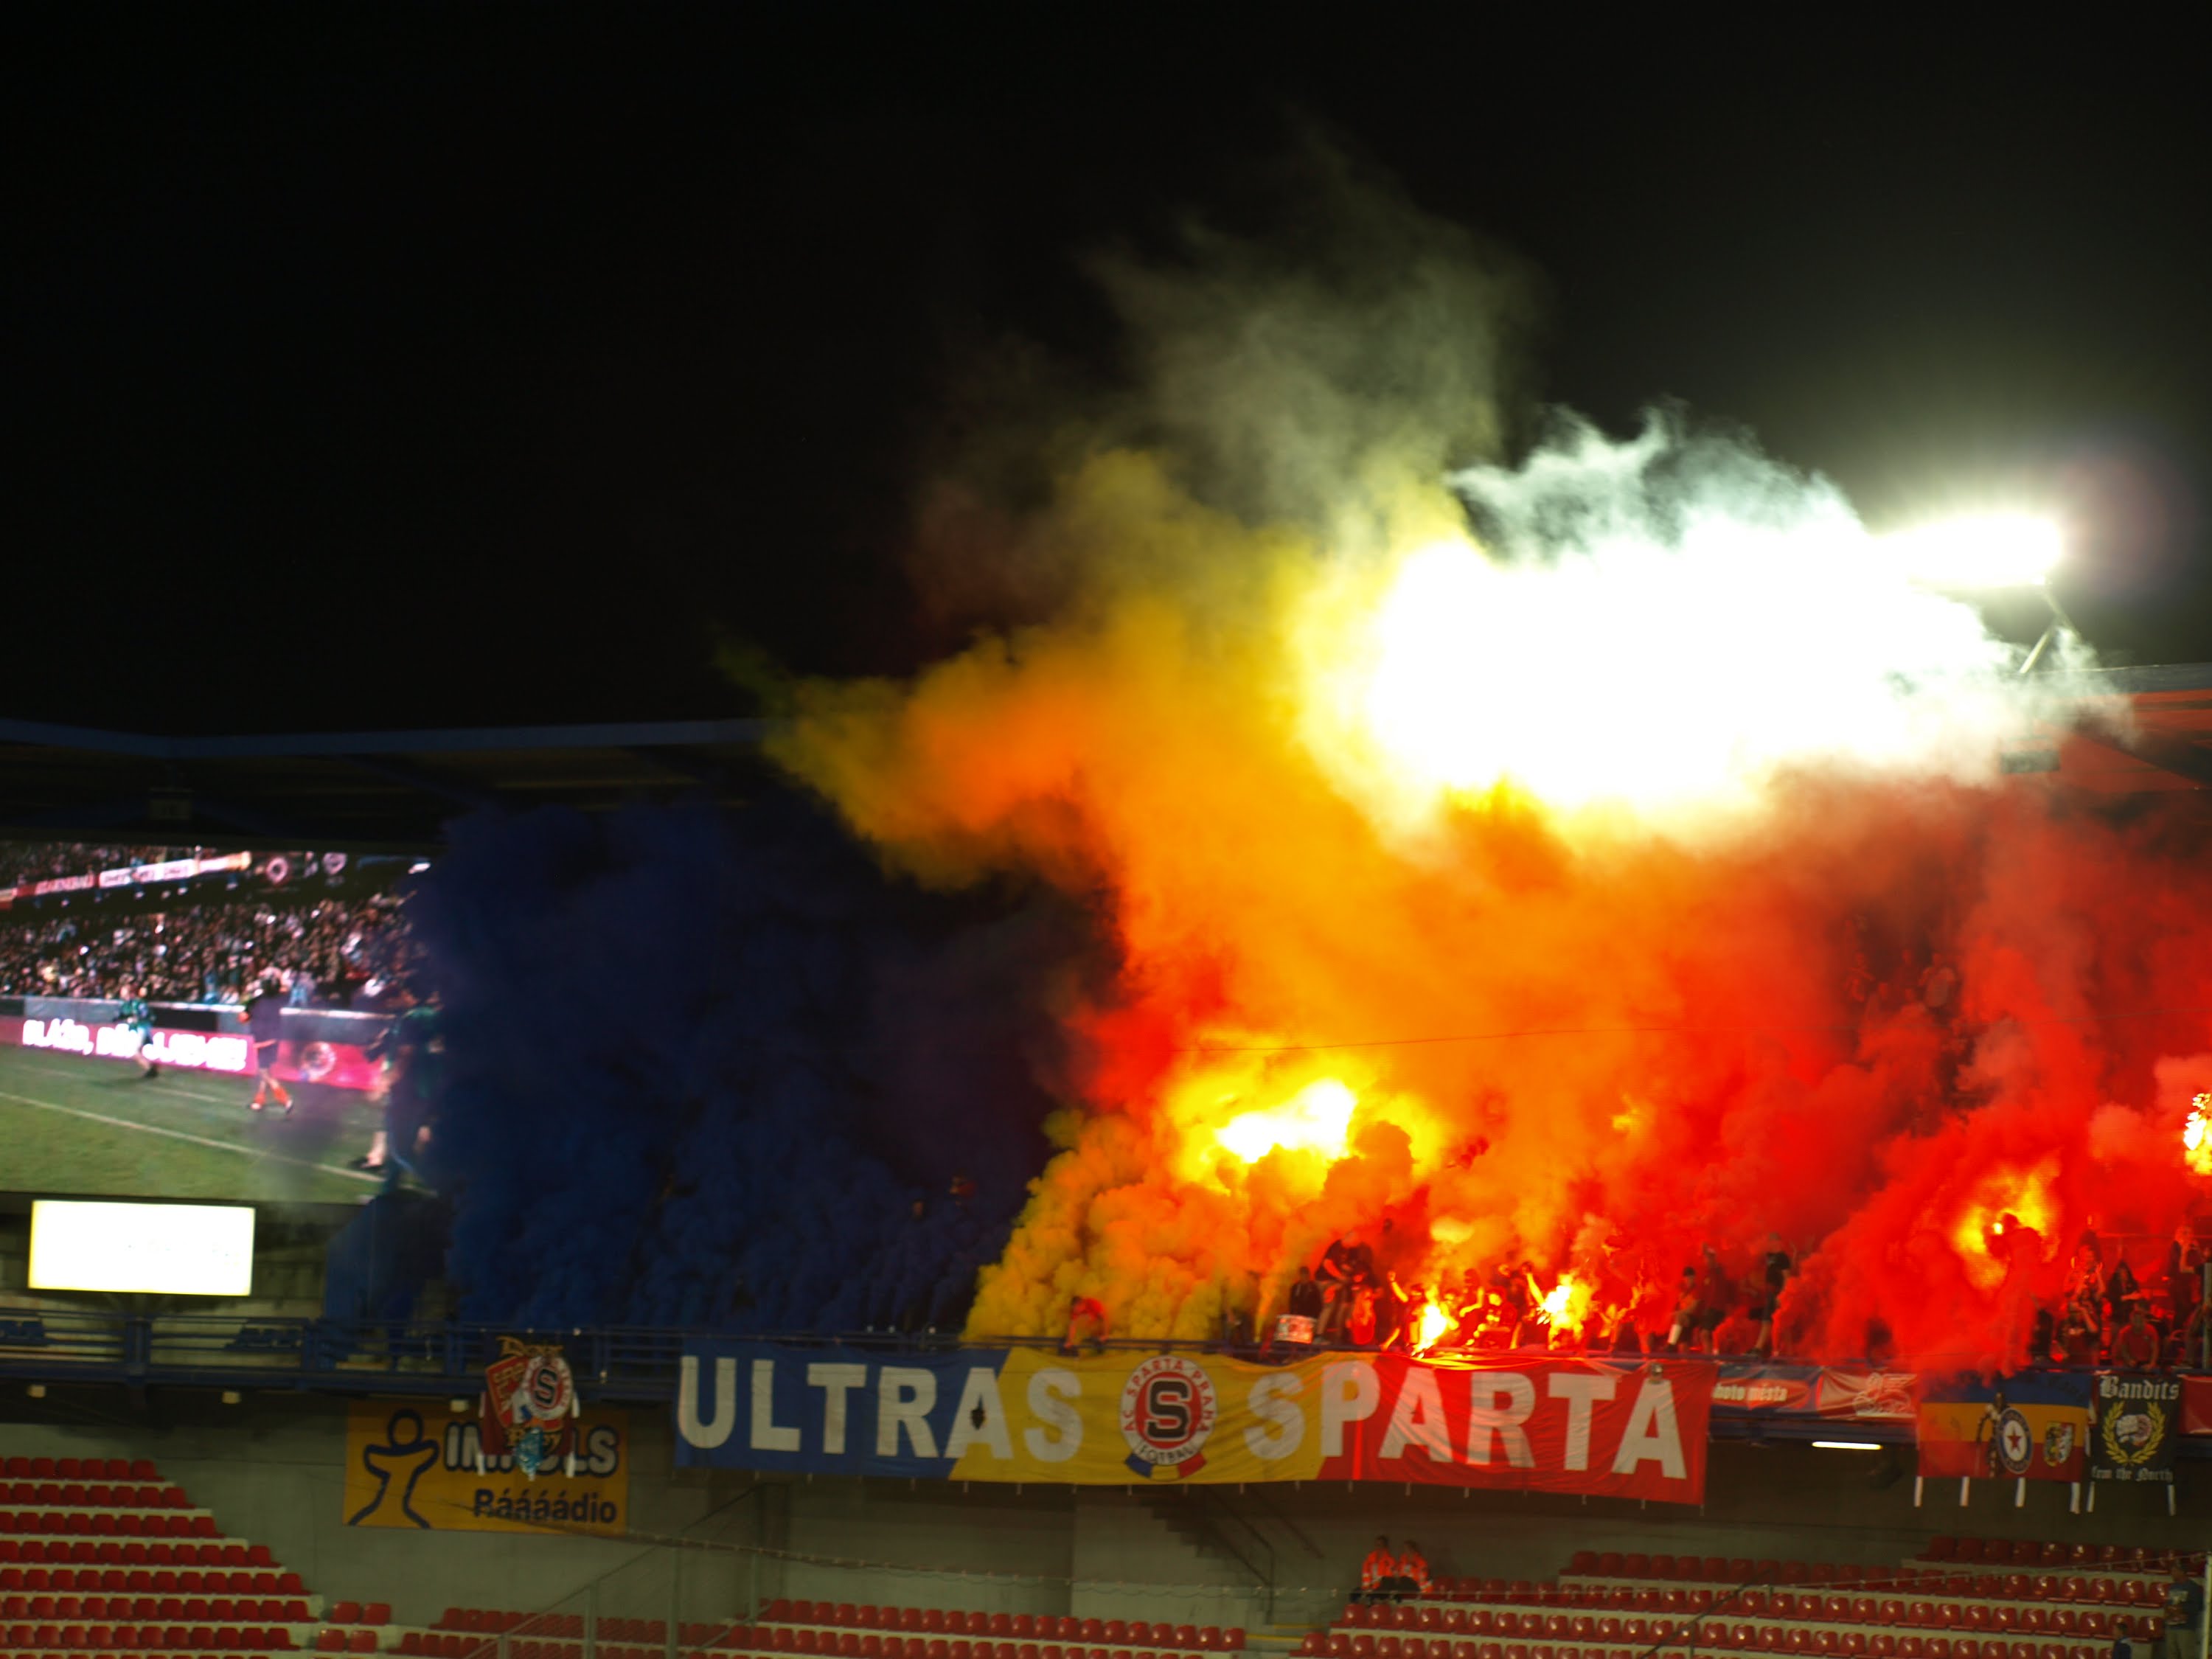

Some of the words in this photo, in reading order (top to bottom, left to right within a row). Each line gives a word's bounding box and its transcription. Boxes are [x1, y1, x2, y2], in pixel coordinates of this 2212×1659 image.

[1127, 1358, 1183, 1397] SPARTA
[1192, 1370, 1214, 1432] PRAHA
[2099, 1374, 2180, 1400] Bandits
[678, 1355, 1083, 1464] ULTRAS
[1244, 1360, 1688, 1480] SPARTA
[474, 1488, 617, 1523] Ráááádio
